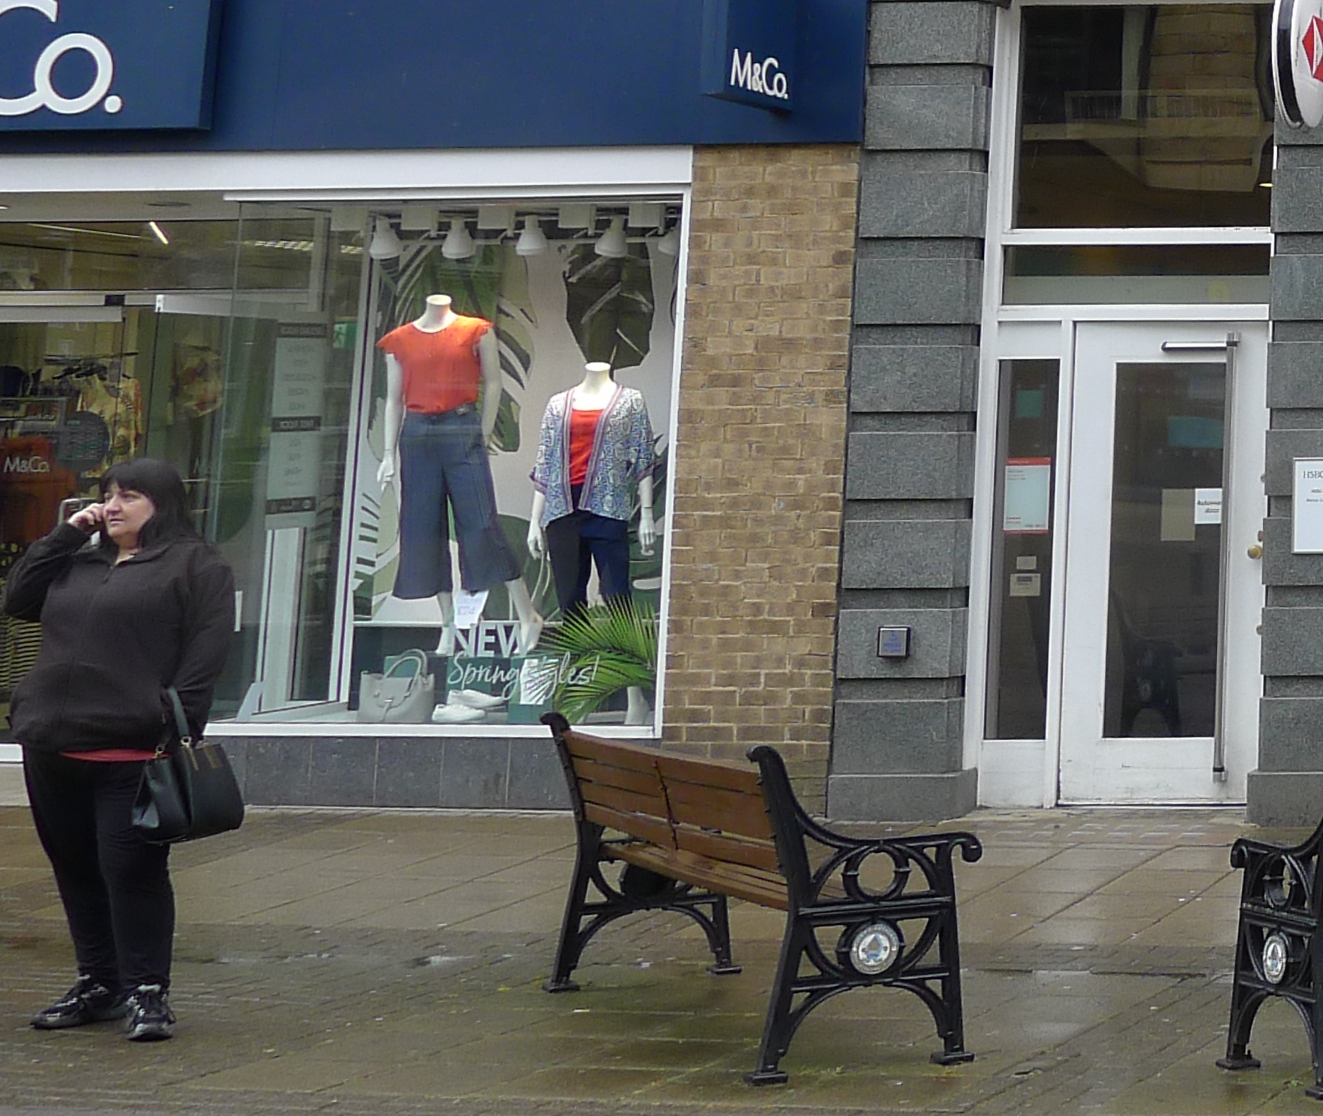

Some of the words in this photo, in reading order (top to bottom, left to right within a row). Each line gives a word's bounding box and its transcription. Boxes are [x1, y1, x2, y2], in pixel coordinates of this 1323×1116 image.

[730, 48, 788, 99] M&Co.
[450, 623, 530, 658] NEW
[448, 651, 523, 701] Spring
